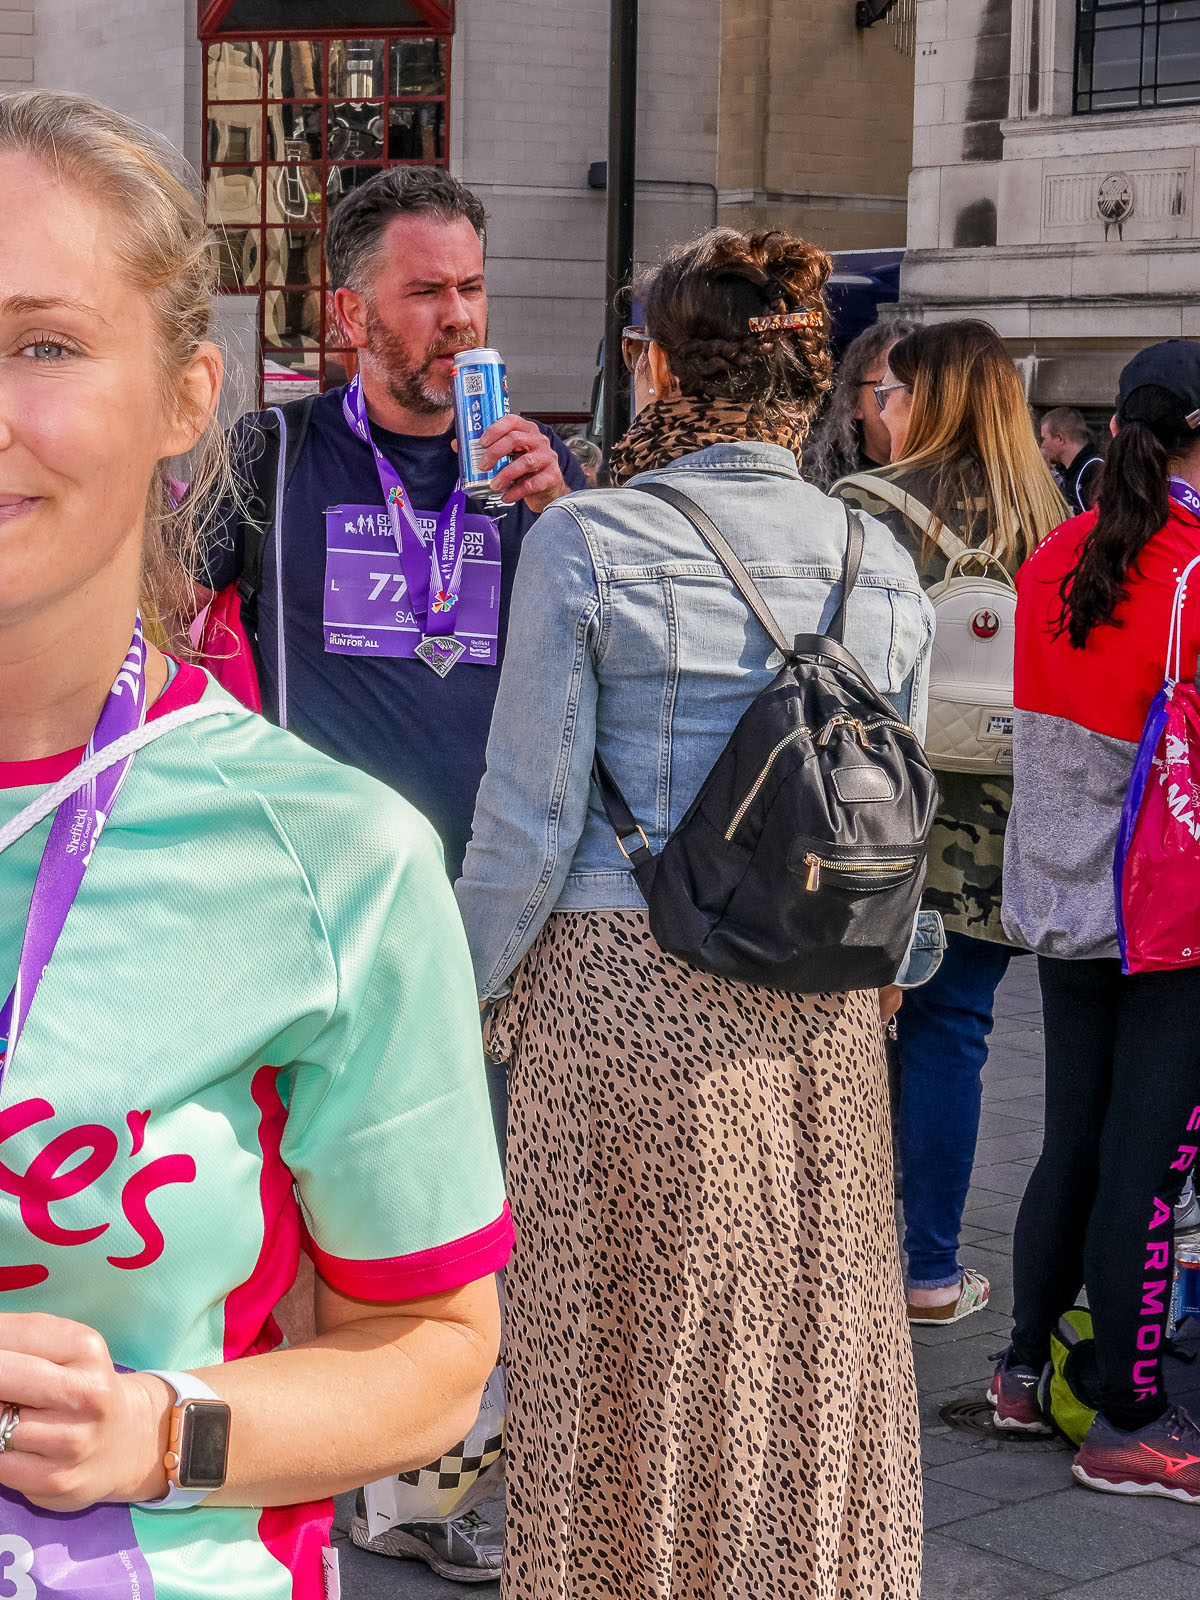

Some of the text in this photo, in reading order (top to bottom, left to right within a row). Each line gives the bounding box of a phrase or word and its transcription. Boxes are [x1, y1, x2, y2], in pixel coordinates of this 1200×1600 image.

[449, 503, 458, 543] MARATHON
[442, 529, 450, 561] SHEFFIELD
[331, 572, 408, 603] L 77
[395, 610, 418, 624] SA
[330, 636, 379, 648] RUN FOR ALL
[65, 808, 88, 856] Sheffield
[80, 816, 93, 852] City Council
